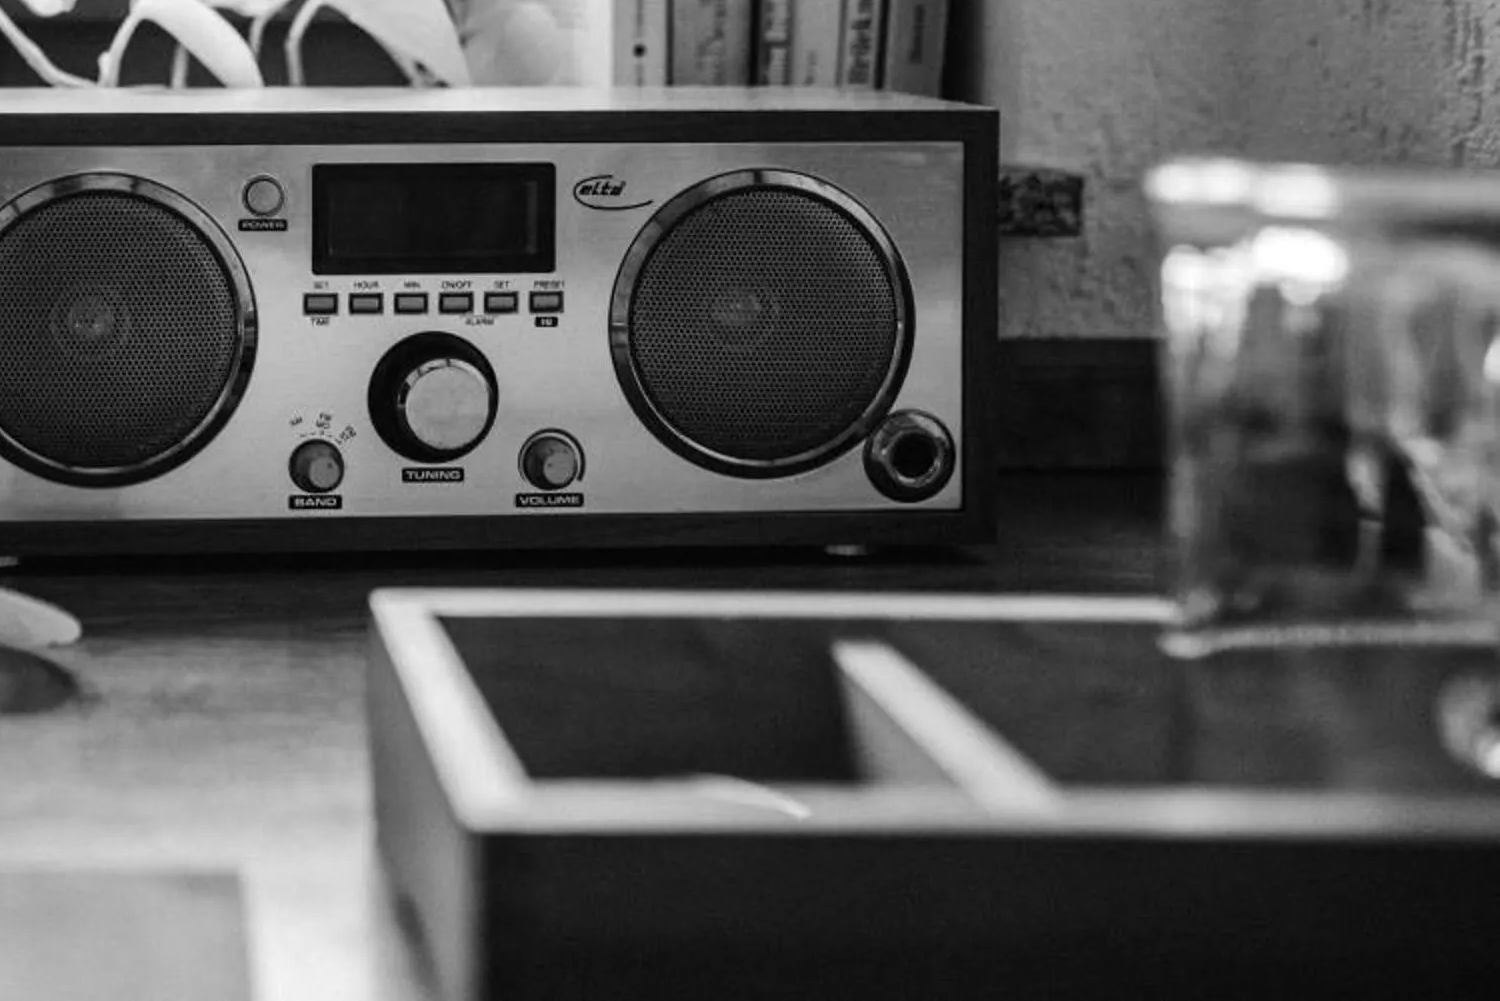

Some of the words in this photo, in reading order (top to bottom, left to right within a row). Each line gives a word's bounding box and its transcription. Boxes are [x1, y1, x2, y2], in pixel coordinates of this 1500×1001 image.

[241, 221, 286, 230] POWER
[353, 280, 379, 289] HOUR
[441, 279, 473, 289] ON/OFF
[494, 280, 510, 289] SET
[533, 280, 565, 289] PRESET
[465, 317, 496, 326] ALARM
[405, 469, 462, 480] TUNING
[294, 497, 337, 507] BAND
[519, 495, 581, 506] VOLUME
